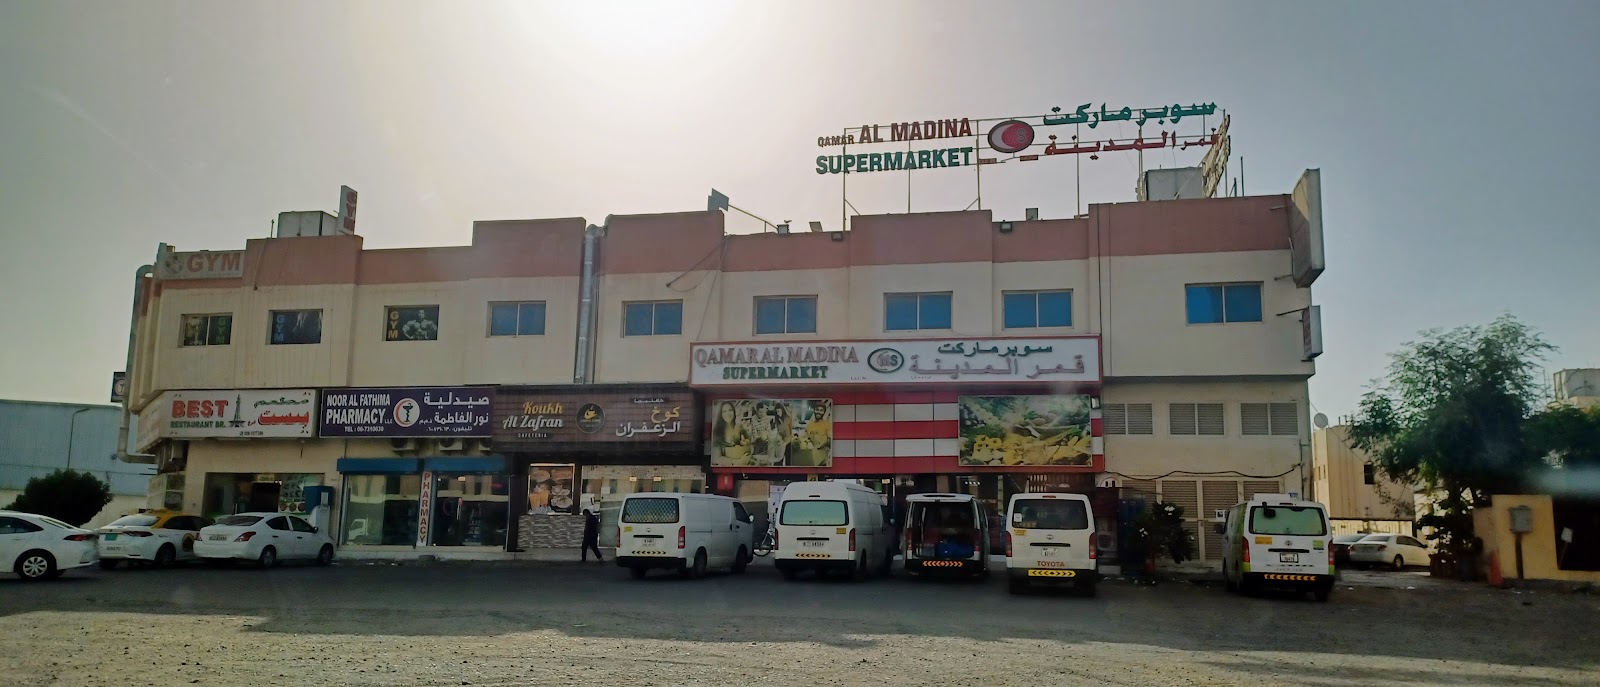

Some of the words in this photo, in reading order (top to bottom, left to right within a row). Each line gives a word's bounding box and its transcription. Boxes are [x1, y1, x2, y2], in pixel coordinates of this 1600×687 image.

[1044, 102, 1132, 129] ماركت
[1136, 102, 1217, 126] سوبر
[817, 135, 854, 147] QAMAR
[859, 124, 883, 144] AL
[891, 118, 972, 142] MADINA
[816, 146, 972, 174] SUPERMARKET
[343, 190, 357, 232] GYM
[186, 252, 240, 272] GYM
[217, 315, 225, 344] GYM
[275, 314, 284, 342] GYM
[387, 310, 398, 340] GYM
[694, 348, 758, 367] QAMAR
[761, 347, 784, 364] AL
[787, 346, 858, 364] MADINA
[938, 342, 998, 357] ماركت
[998, 345, 1052, 357] سوبر
[723, 366, 828, 380] SUPERMARKET
[909, 354, 1019, 380] المدينة
[1026, 354, 1084, 379] قمر
[326, 394, 346, 406] NOOR
[349, 394, 358, 406] AL
[359, 393, 391, 406] FATHIMA
[424, 392, 490, 408] صيدلية
[522, 401, 564, 415] Koukh
[172, 400, 228, 418] BEST
[326, 408, 386, 425] PHARMACY
[650, 406, 681, 423] كوخ
[170, 420, 213, 428] RESTAURANT
[434, 411, 472, 425] الفاطمة
[473, 412, 488, 426] نور
[502, 415, 518, 430] Al
[520, 415, 564, 431] Zafran
[616, 422, 681, 438] الزعفران
[418, 472, 431, 543] PHARMACY
[1036, 560, 1066, 568] TOYOTA
